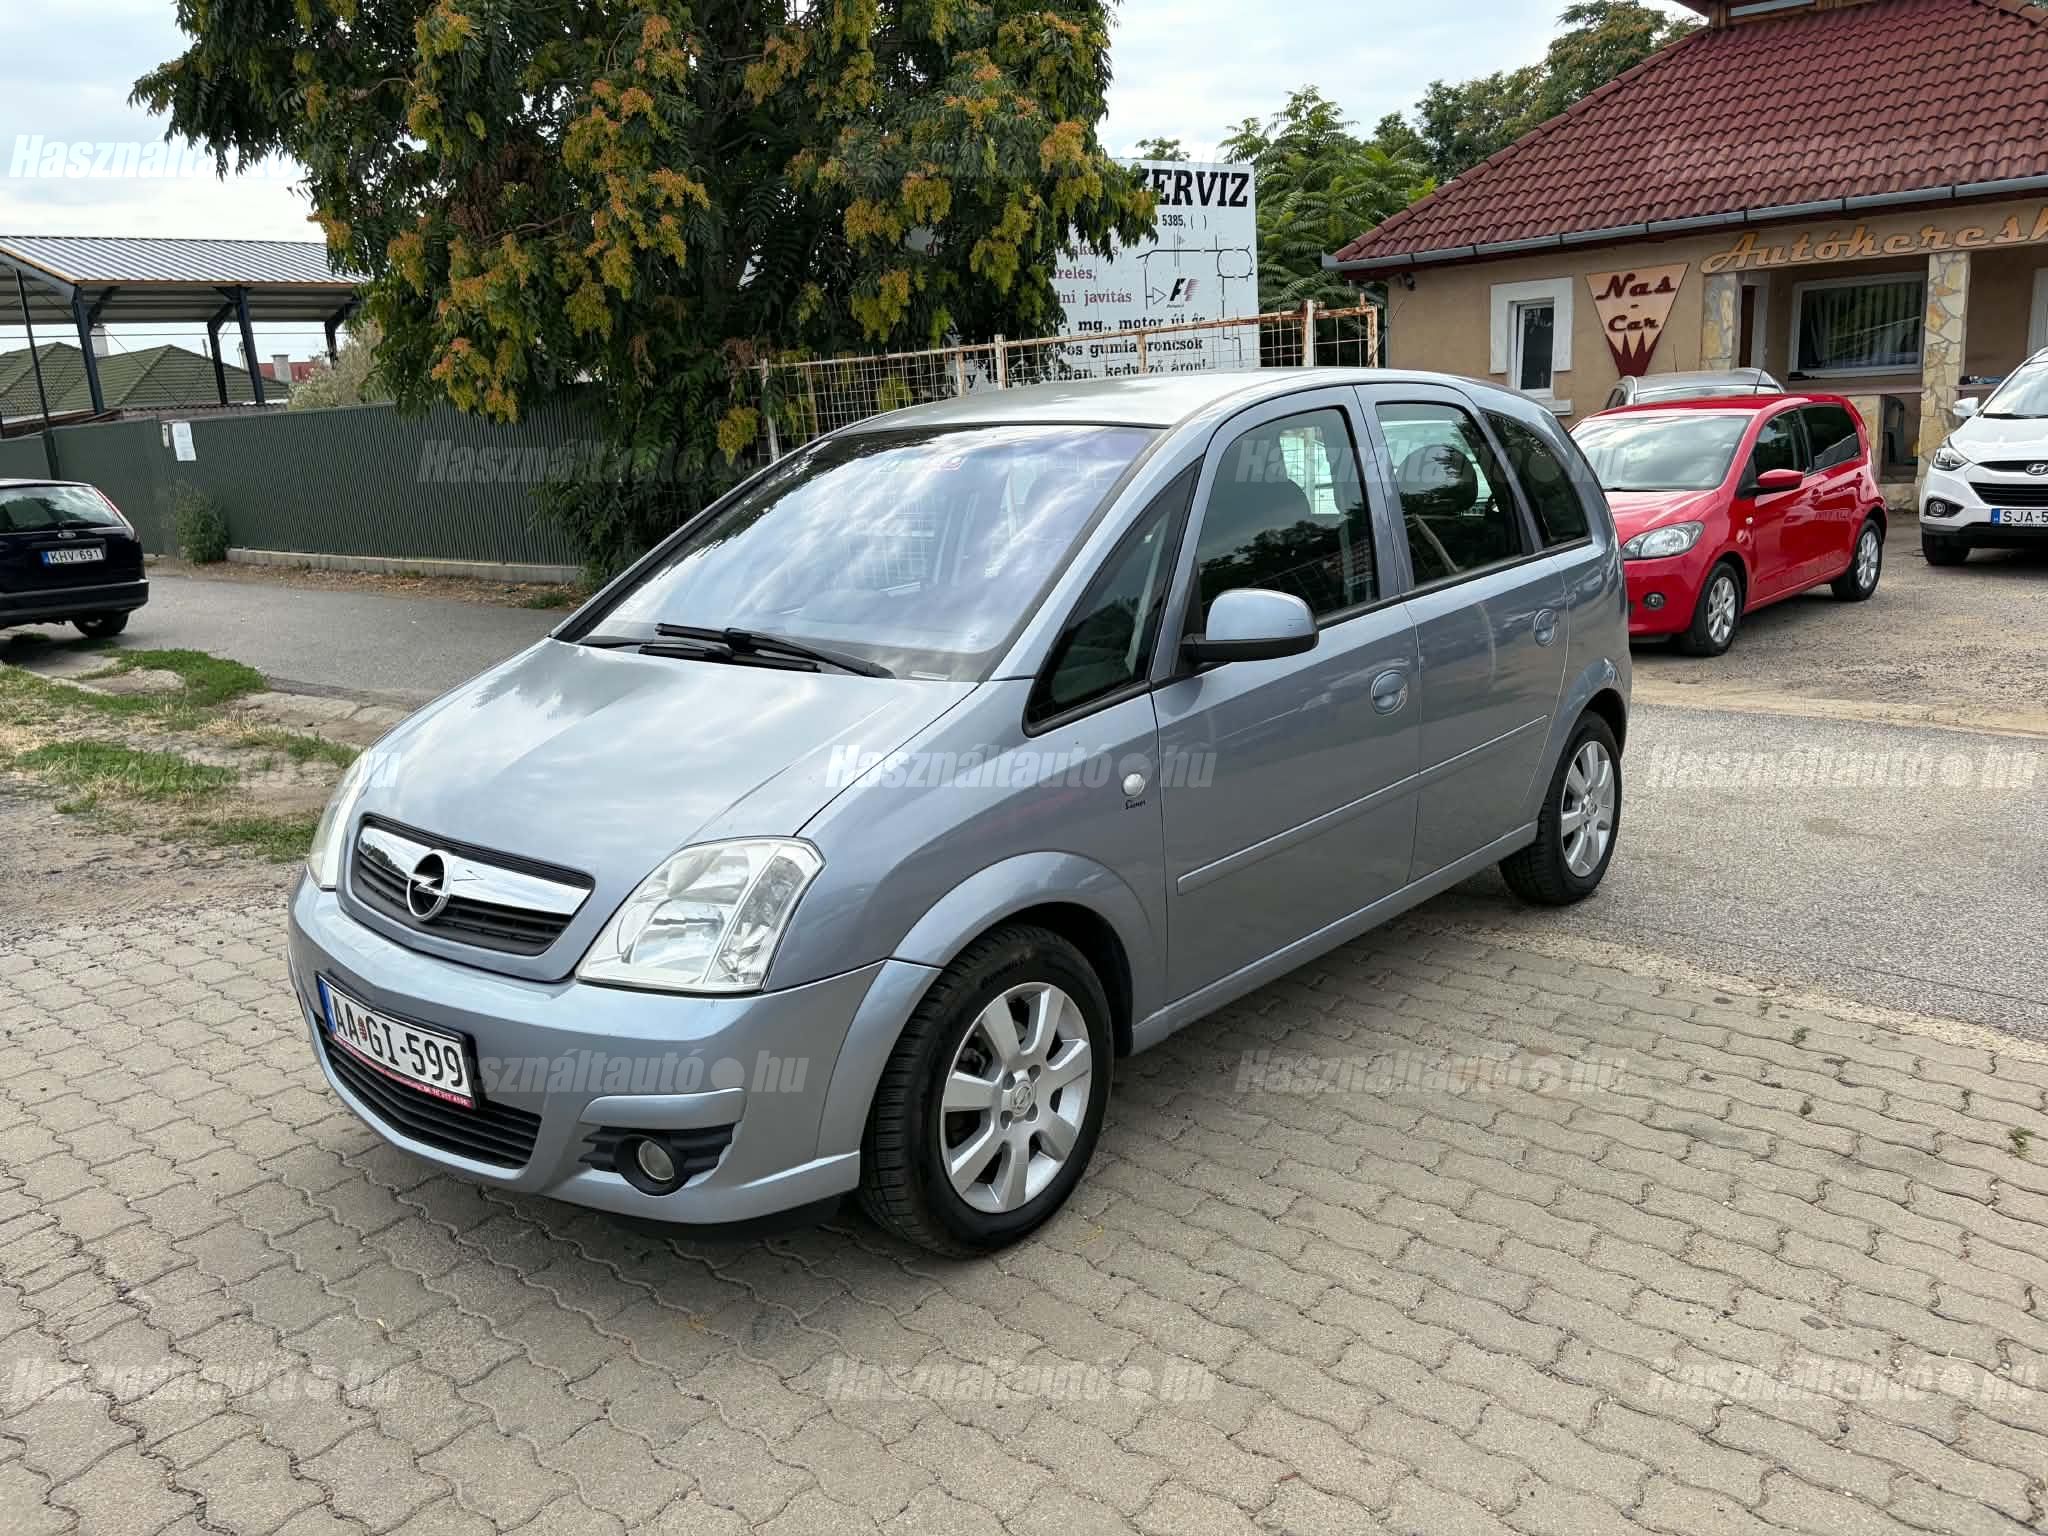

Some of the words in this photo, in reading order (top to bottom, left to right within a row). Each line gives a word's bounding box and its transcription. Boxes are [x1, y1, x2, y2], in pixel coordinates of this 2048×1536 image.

[1595, 273, 1677, 301] Nas
[1084, 287, 1133, 307] javítás
[1118, 316, 1164, 330] motor
[1608, 314, 1660, 332] Car
[1090, 339, 1203, 358] gumiaroncsok
[1105, 359, 1164, 377] kedvző
[332, 993, 361, 1047] AA
